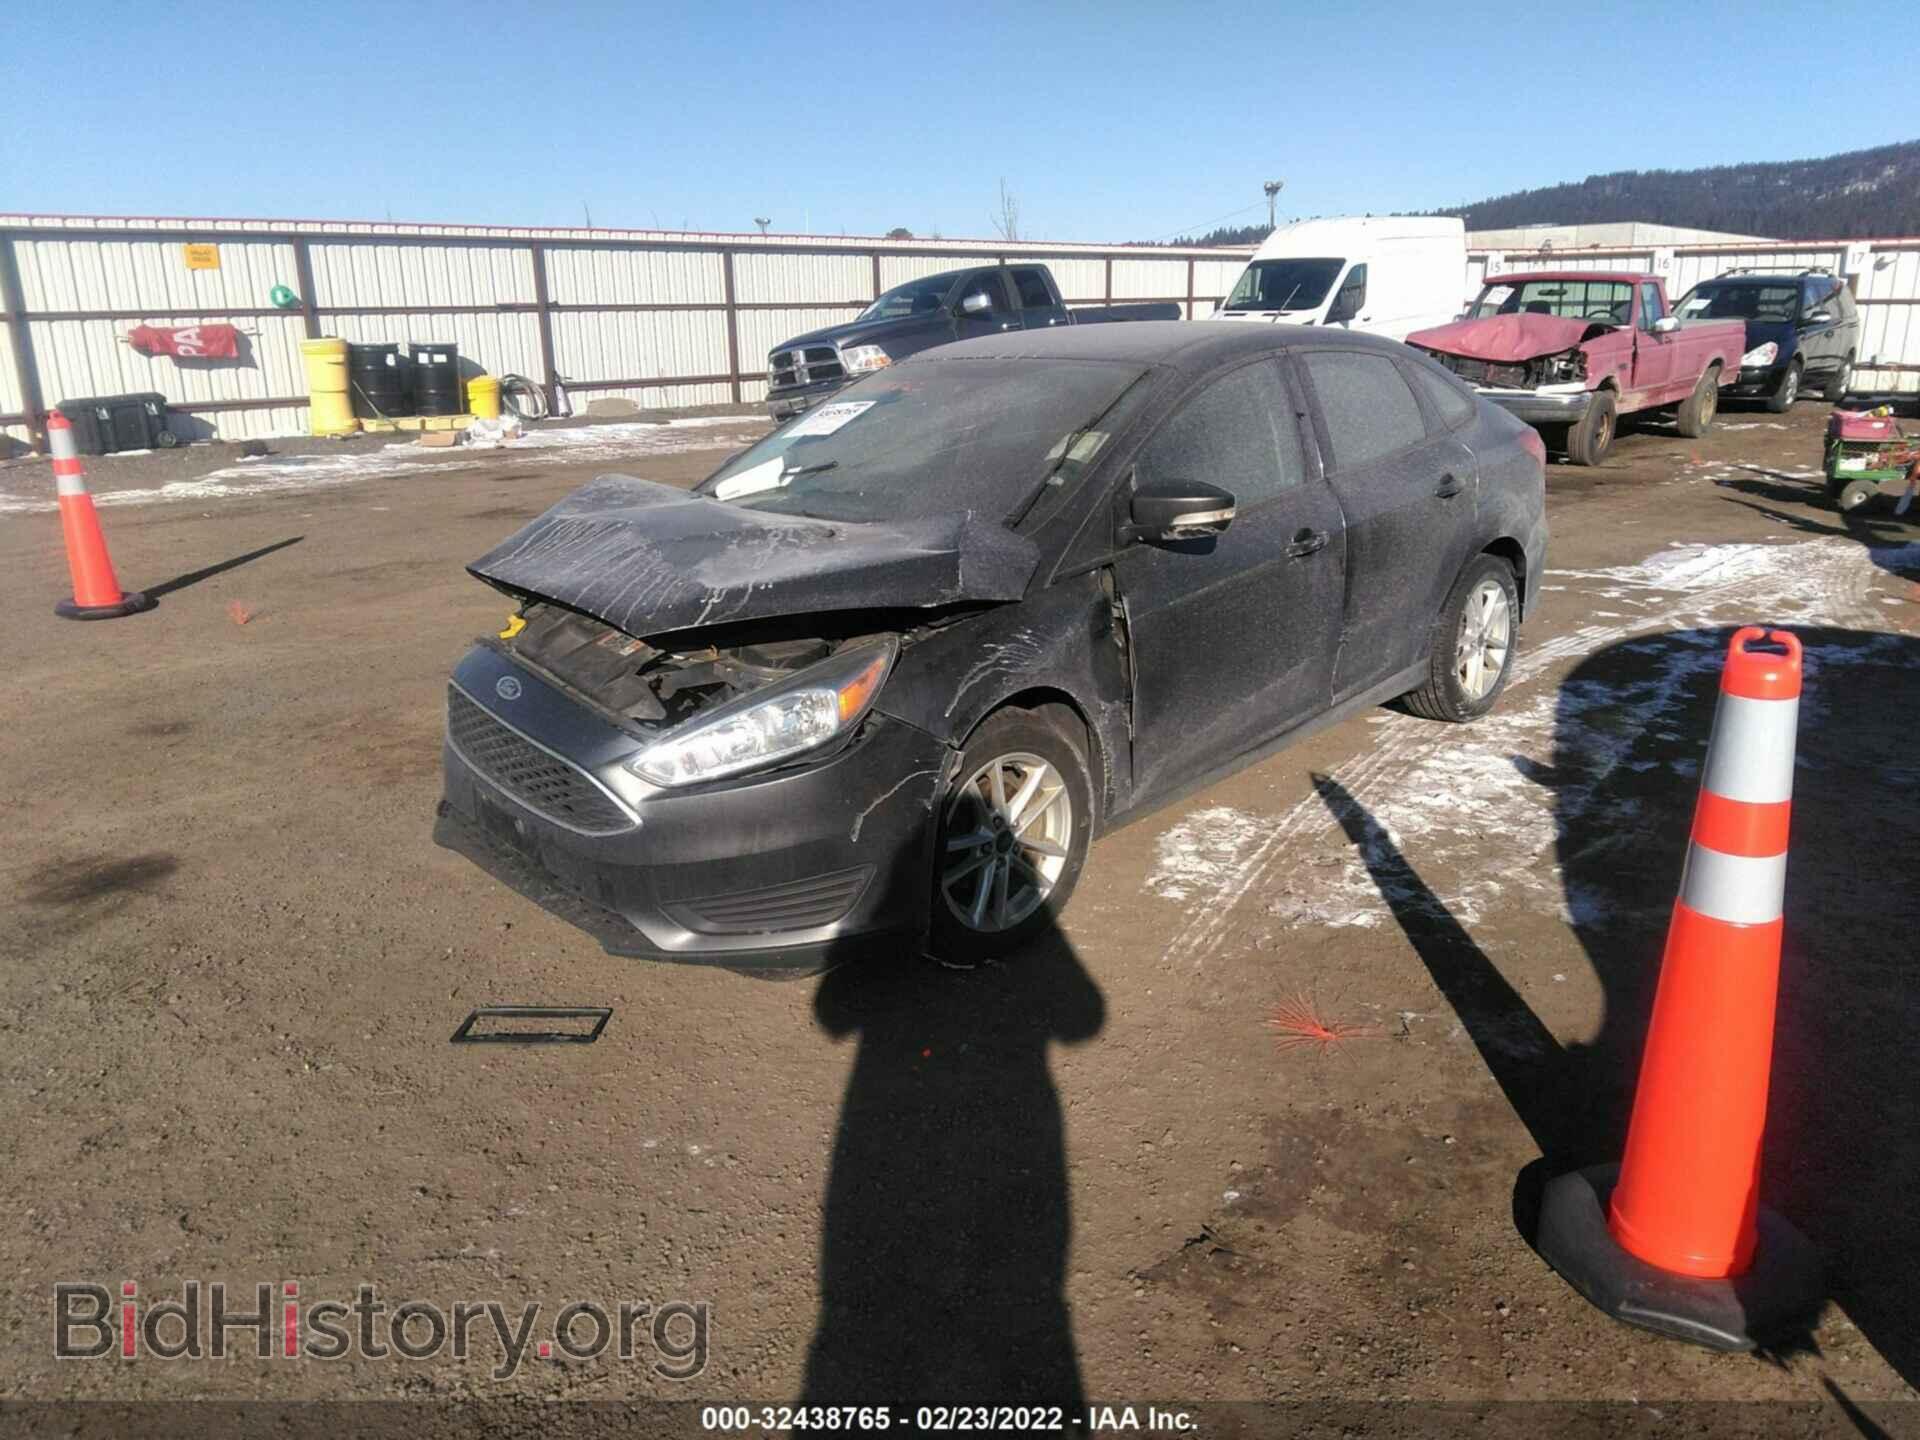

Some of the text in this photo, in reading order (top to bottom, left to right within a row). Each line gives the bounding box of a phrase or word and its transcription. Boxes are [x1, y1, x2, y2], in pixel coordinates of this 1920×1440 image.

[1658, 257, 1670, 269] 16
[1851, 252, 1865, 265] 17
[1490, 261, 1501, 273] 15
